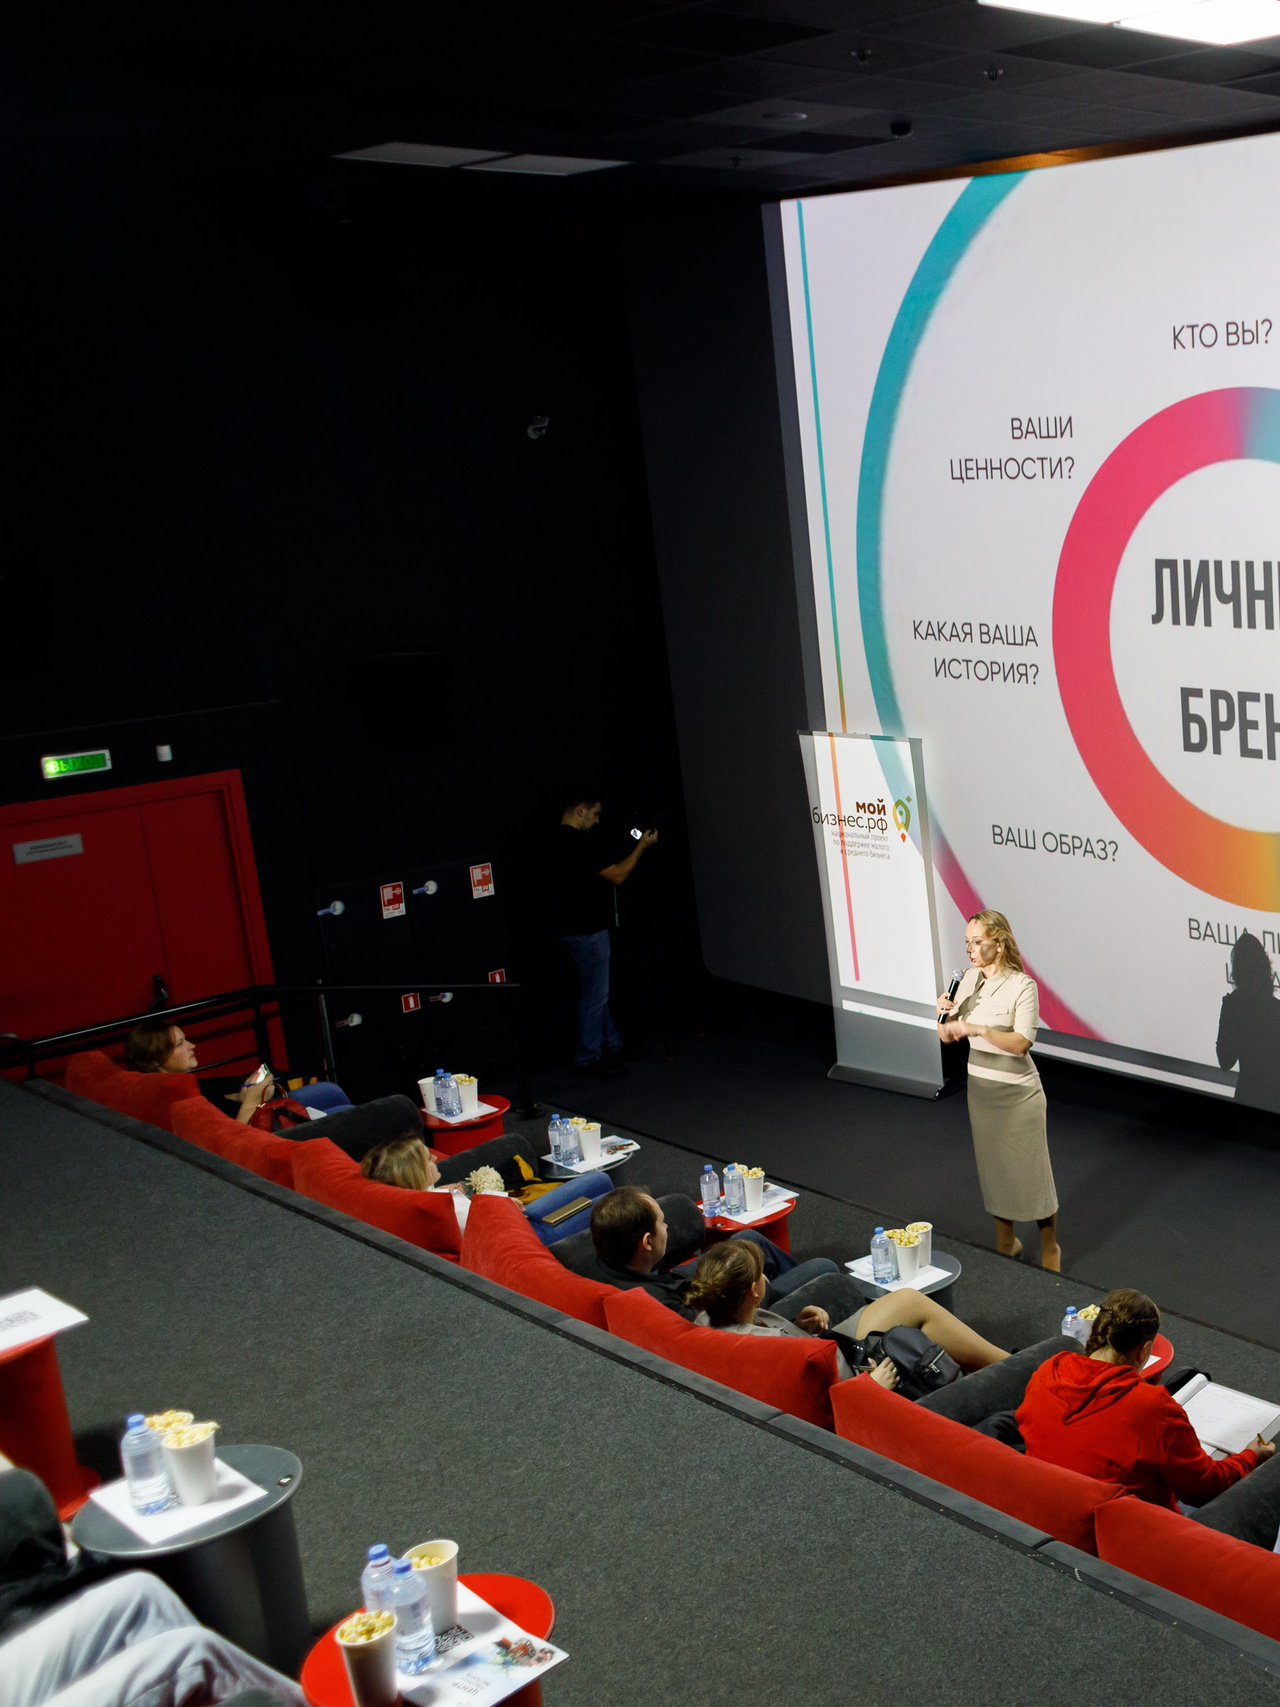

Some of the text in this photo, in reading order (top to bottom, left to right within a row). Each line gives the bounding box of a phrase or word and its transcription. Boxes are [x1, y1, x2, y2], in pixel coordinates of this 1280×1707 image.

[1172, 318, 1273, 350] КТО ВЫ?
[1010, 415, 1073, 440] ВАШИ
[950, 456, 1075, 484] ЦЕННОСТИ?
[912, 619, 1039, 647] КАКАЯ ВАША
[933, 657, 1039, 685] ИСТОРИЯ?
[812, 806, 888, 835] бизнес.рф
[855, 798, 887, 816] мой
[870, 834, 889, 842] проект
[991, 824, 1119, 861] ВАШ ОБРАЗ?
[1188, 917, 1250, 946] ВАШ
